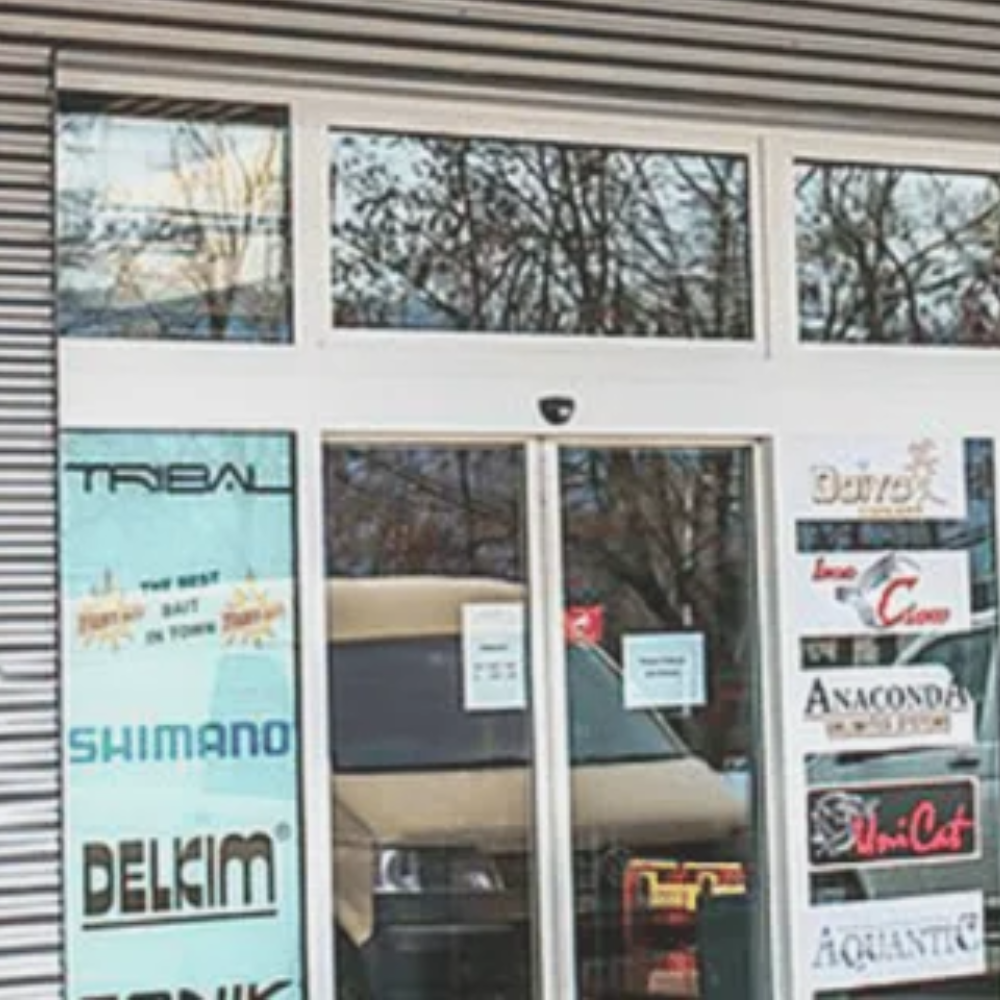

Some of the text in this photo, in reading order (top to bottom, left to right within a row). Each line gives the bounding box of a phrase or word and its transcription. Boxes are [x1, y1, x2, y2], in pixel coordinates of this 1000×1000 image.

[64, 461, 293, 494] TRIBAL
[804, 676, 970, 716] ANACONDA
[68, 719, 291, 764] SHIMANO
[82, 831, 276, 917] DELKIM
[812, 912, 979, 971] AQUANTIC
